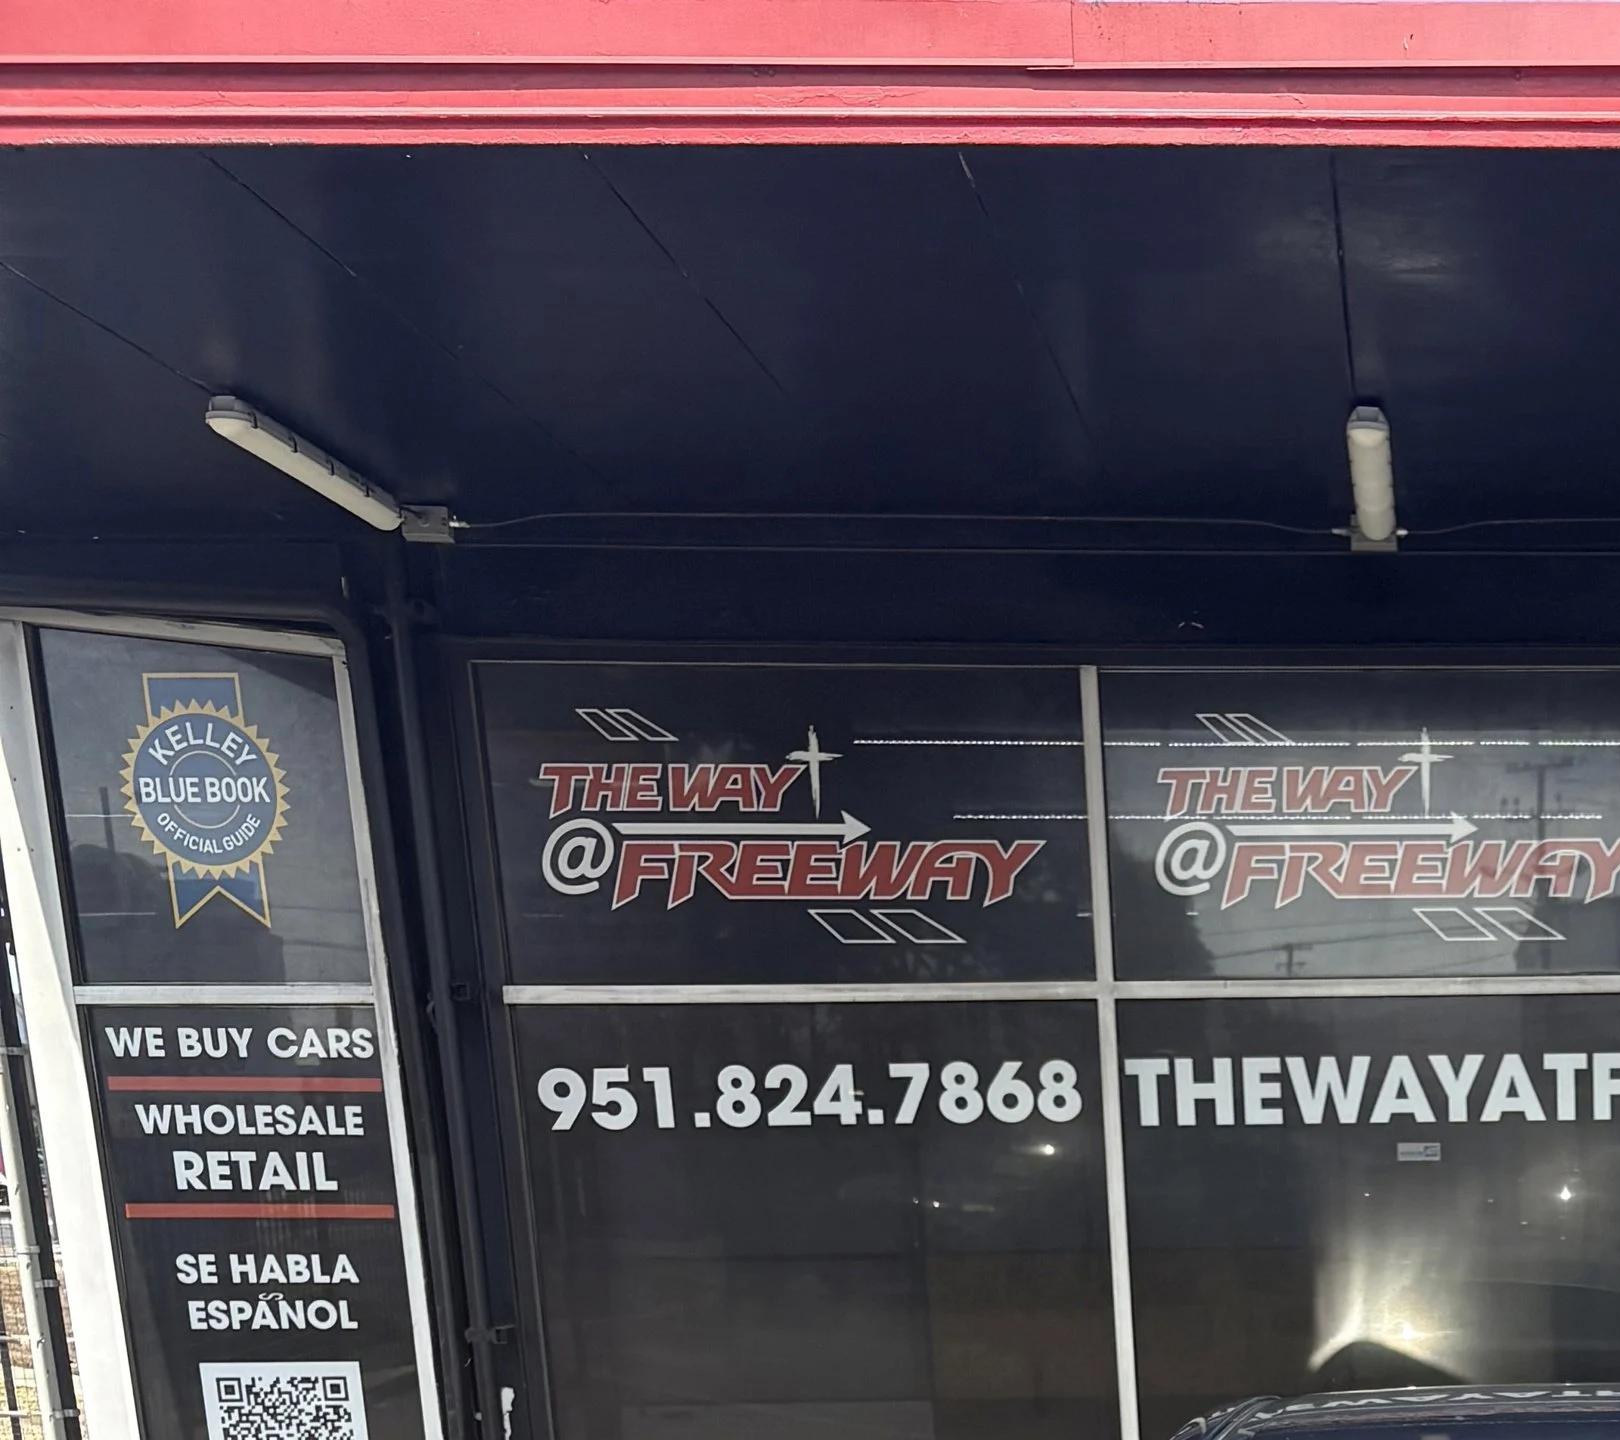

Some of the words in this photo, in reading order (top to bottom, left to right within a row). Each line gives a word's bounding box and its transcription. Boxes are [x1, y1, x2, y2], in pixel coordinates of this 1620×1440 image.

[148, 722, 258, 766] KELLEY
[138, 777, 201, 803] BLUE
[204, 776, 271, 803] BOOK
[157, 812, 224, 854] OFFICIAL
[222, 813, 261, 851] GUIDE
[104, 1027, 166, 1058] WE
[176, 1027, 253, 1058] BUY
[266, 1028, 374, 1059] CARS
[537, 1059, 1083, 1131] 951.824.7868
[134, 1104, 364, 1136] WHOLESALE
[172, 1150, 339, 1191] RETAIL
[175, 1253, 219, 1284] SE
[229, 1253, 360, 1284] HABLA
